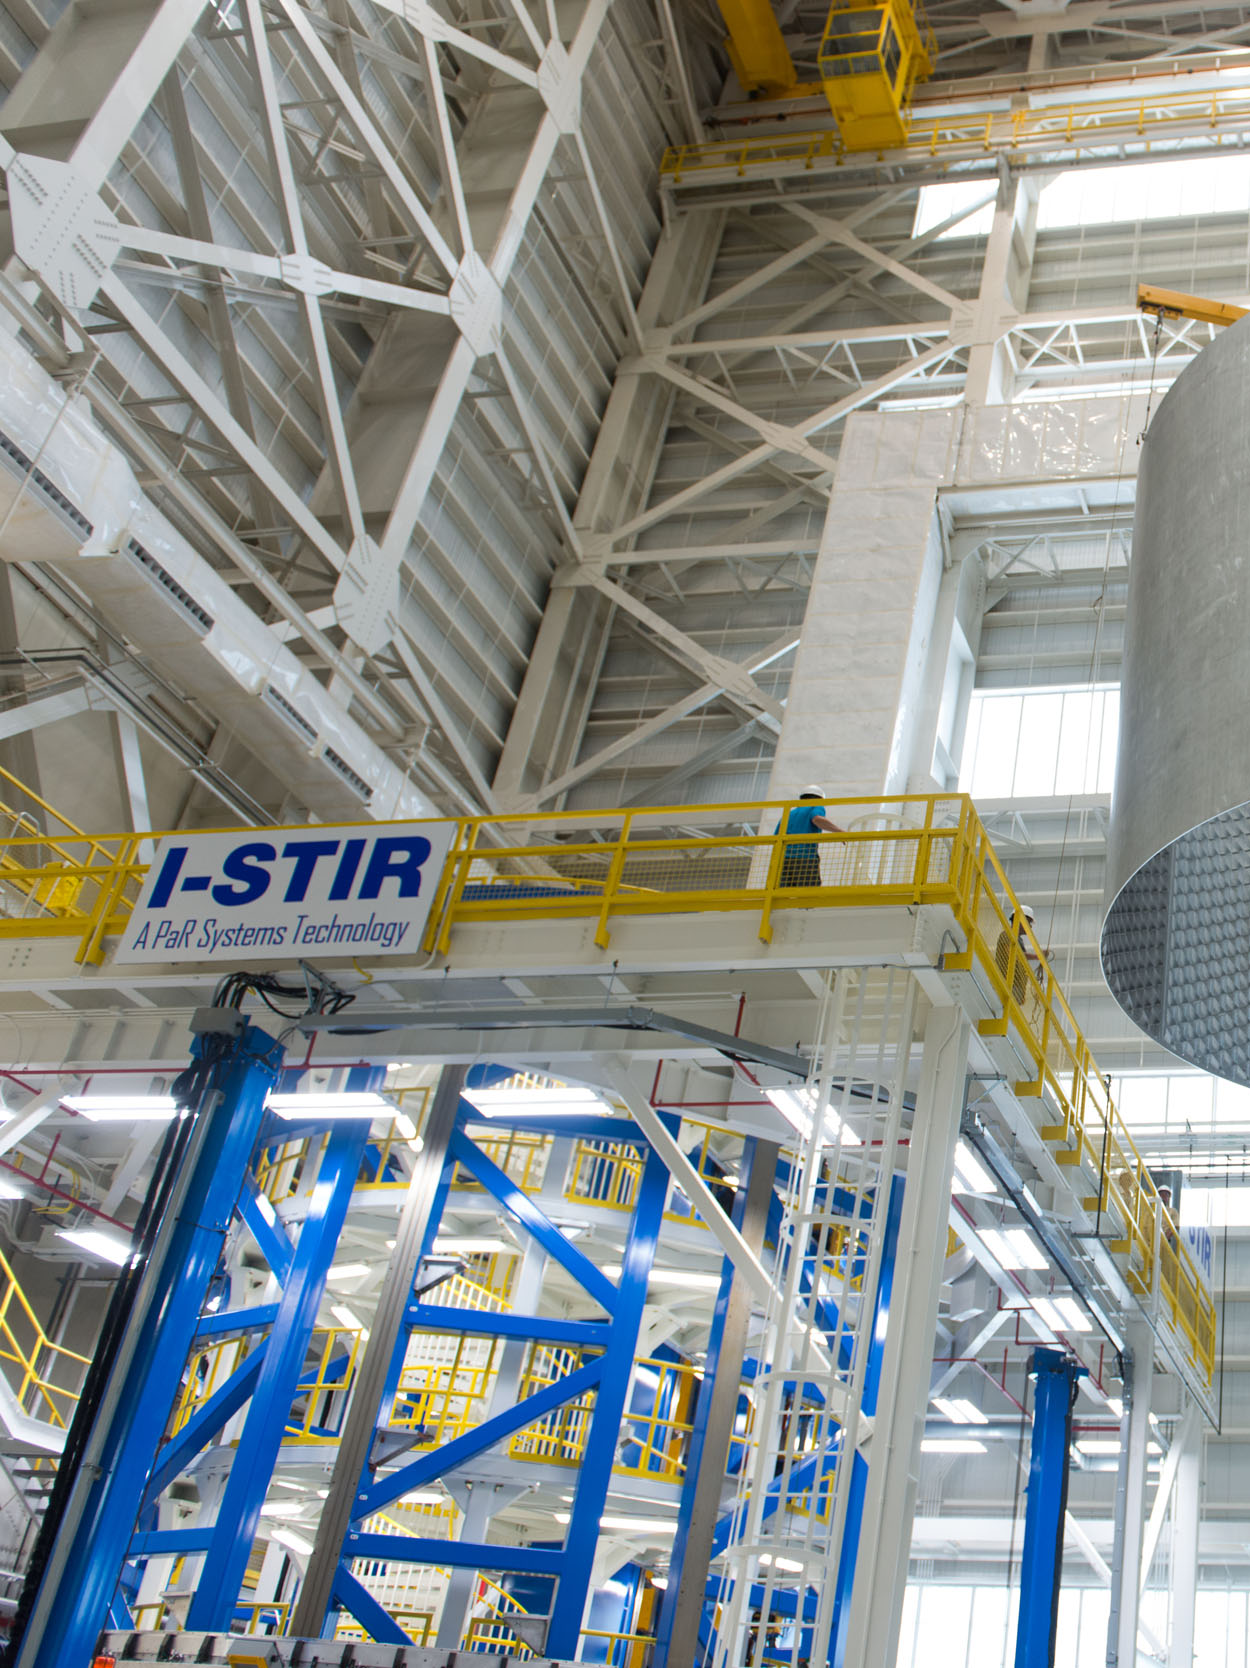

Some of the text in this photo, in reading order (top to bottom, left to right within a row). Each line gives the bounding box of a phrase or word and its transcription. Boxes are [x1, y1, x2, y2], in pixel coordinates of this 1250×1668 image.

[147, 836, 432, 909] I-STIR
[132, 913, 410, 953] A PaR Systems Technology
